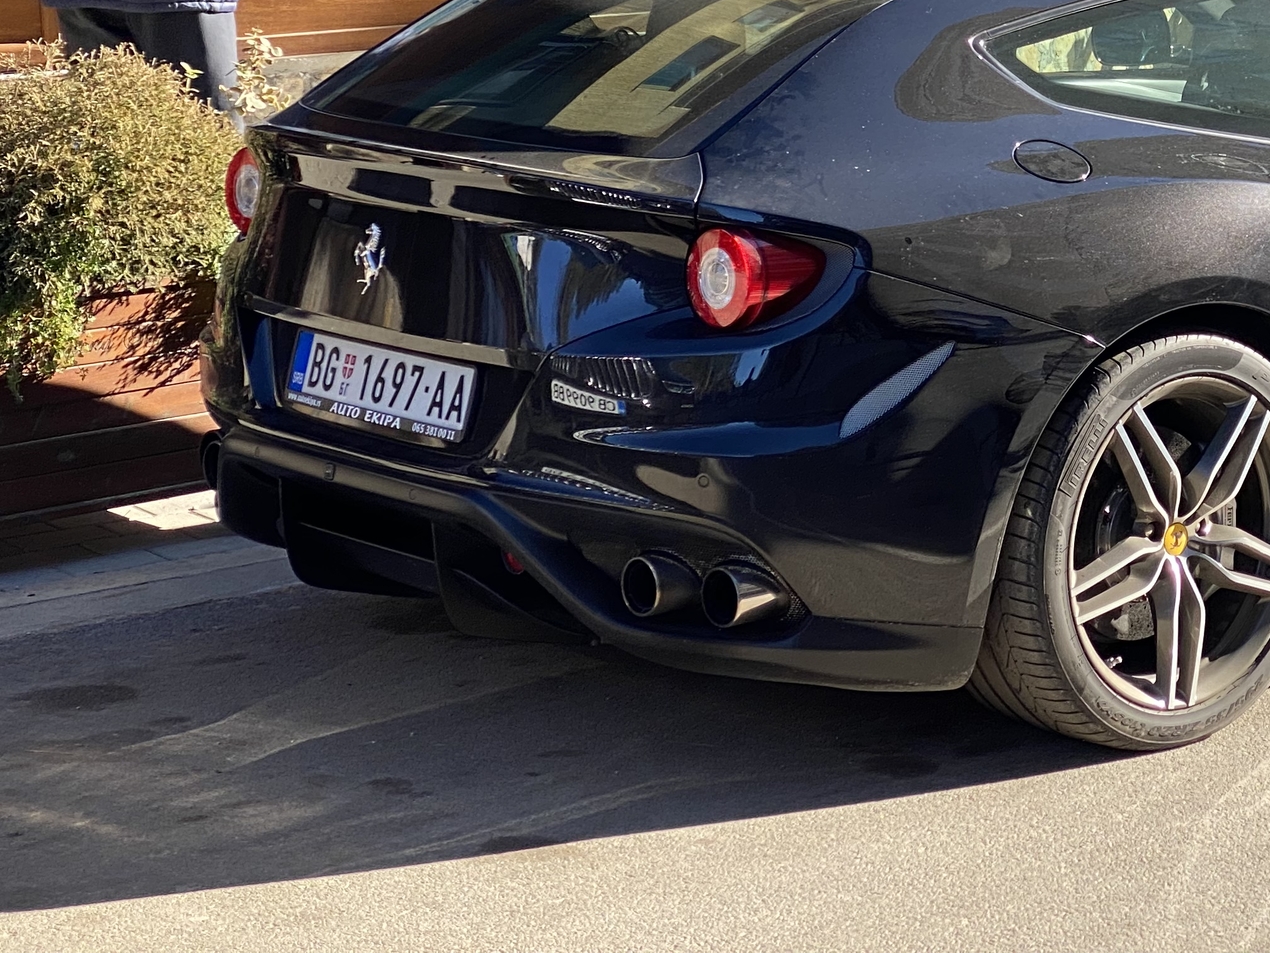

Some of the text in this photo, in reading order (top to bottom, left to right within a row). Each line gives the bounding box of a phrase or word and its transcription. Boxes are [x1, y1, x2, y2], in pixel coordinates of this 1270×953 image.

[292, 371, 304, 385] SRB
[307, 342, 340, 391] BG
[328, 401, 401, 430] AUTO EKIPA
